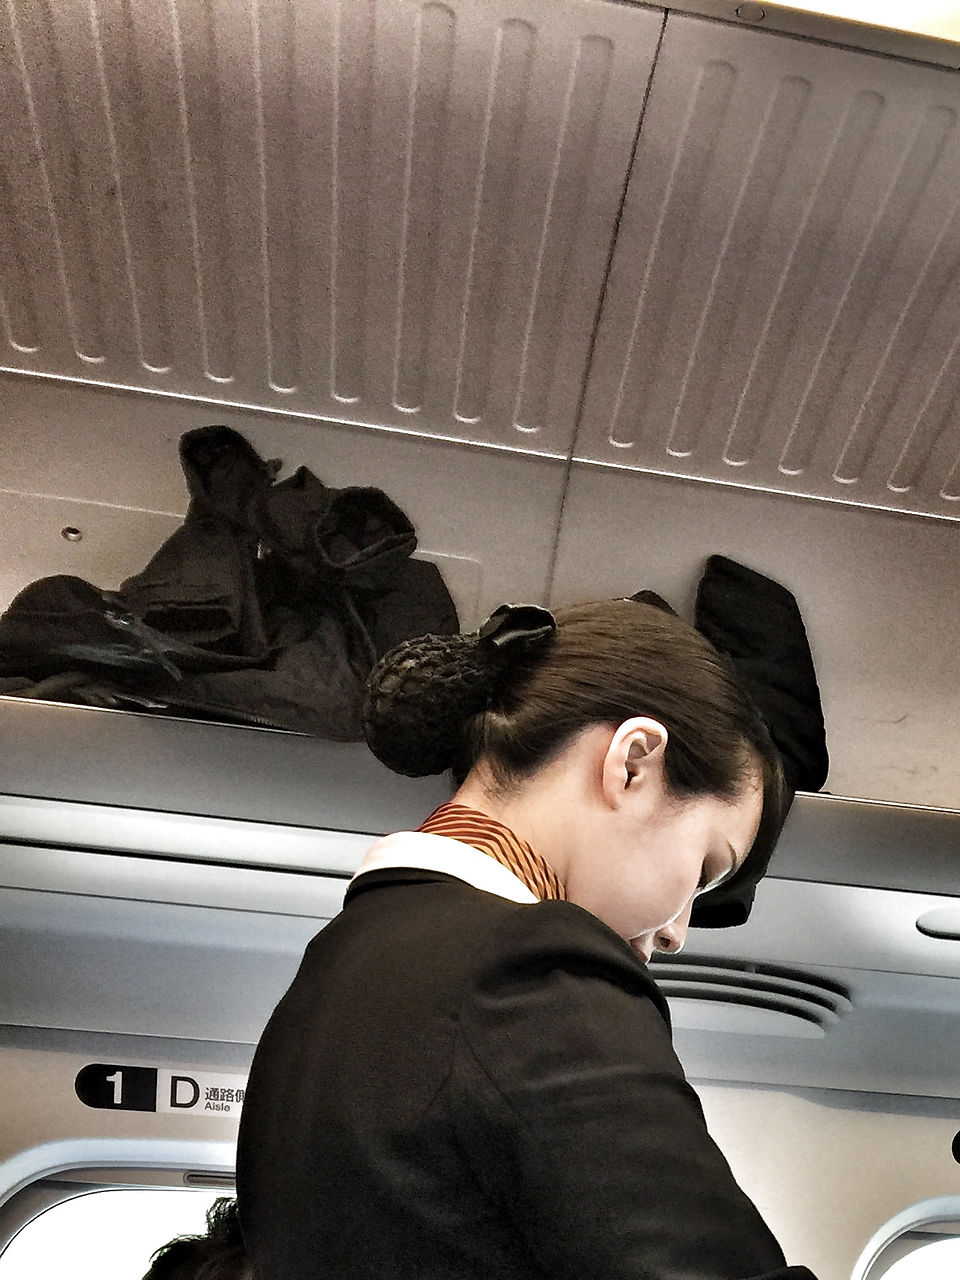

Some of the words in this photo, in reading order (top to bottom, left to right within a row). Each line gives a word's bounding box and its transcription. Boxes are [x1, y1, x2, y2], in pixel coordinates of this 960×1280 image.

[106, 1071, 123, 1105] 1
[170, 1075, 200, 1109] D
[204, 1101, 231, 1112] Aisle
